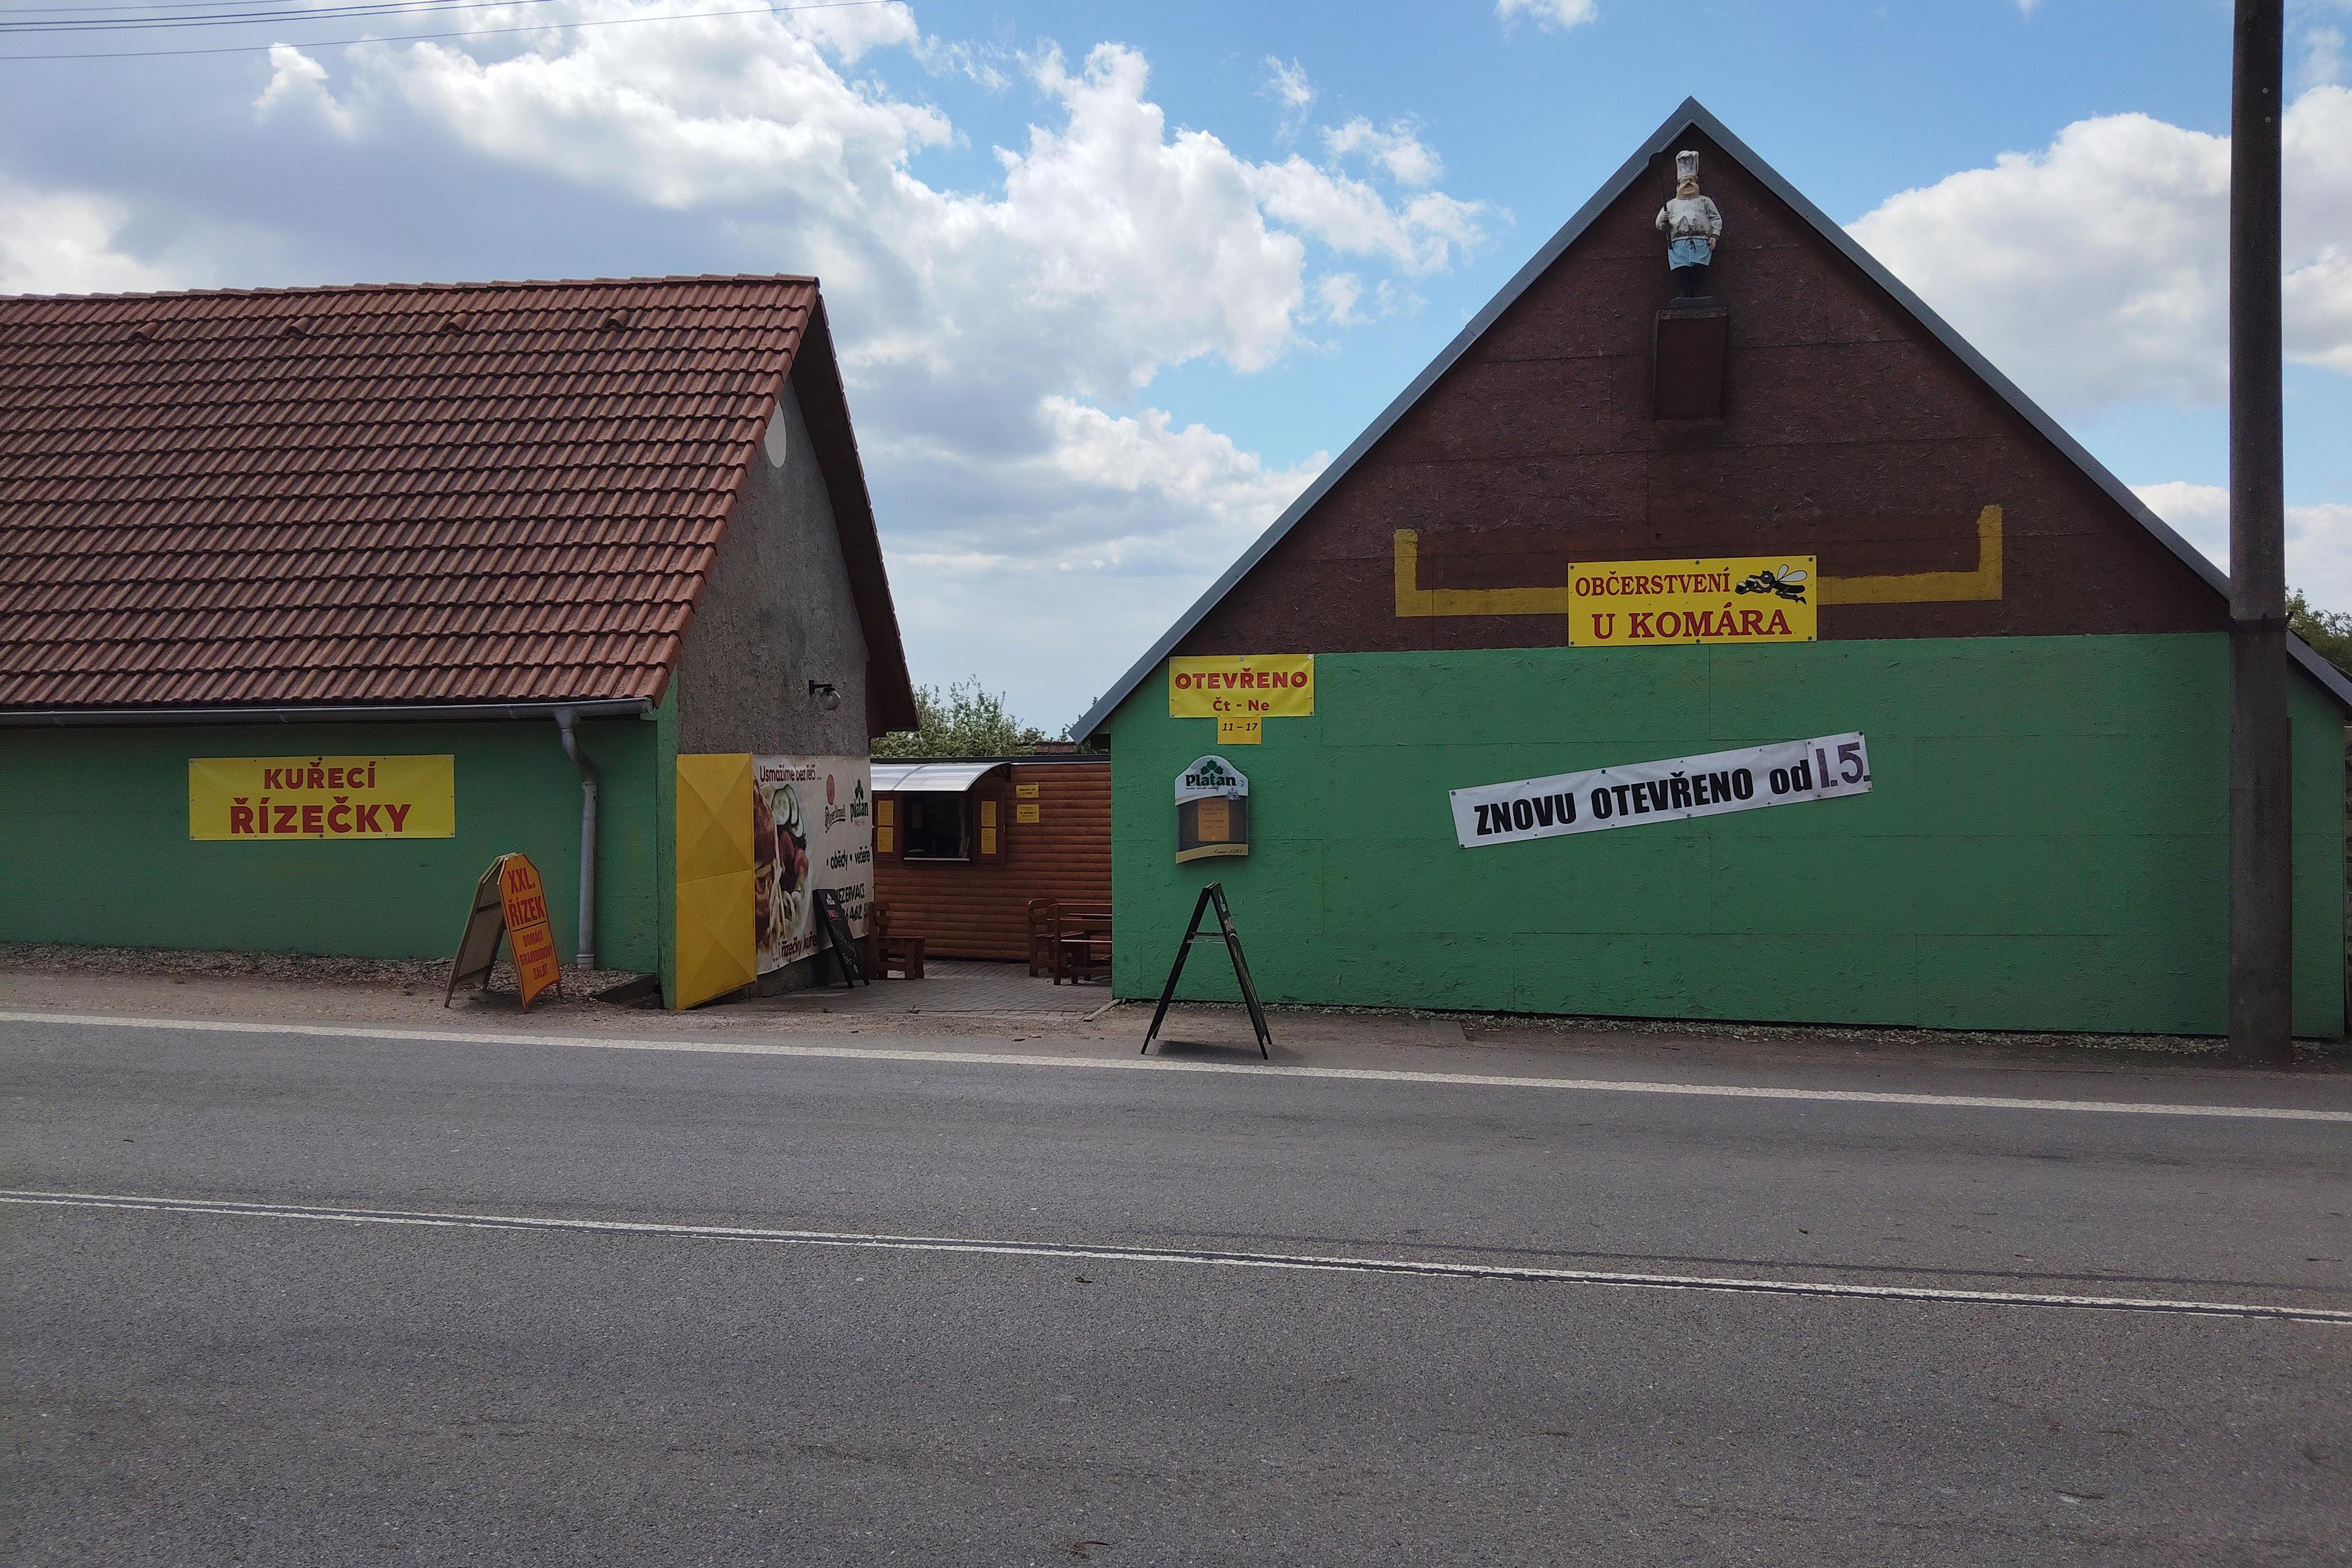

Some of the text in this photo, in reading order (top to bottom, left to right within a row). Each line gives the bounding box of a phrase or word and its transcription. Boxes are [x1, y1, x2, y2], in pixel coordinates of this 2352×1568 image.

[1575, 567, 1731, 597] OBČERSTVENÍ
[1591, 602, 1792, 639] U KOMÁRA
[1175, 667, 1308, 690] OTEVŘENO
[1212, 697, 1231, 711] Čt
[1248, 700, 1270, 711] Ne
[1222, 723, 1234, 731] 11
[1245, 723, 1258, 731] 17
[264, 761, 377, 789] KUŘECÍ
[760, 764, 794, 783] Usmažíme
[794, 765, 806, 781] bez
[1474, 792, 1576, 836] ZNOVU
[1591, 768, 1754, 820] OTEVŘENO
[1769, 759, 1812, 794] od
[230, 796, 412, 834] ŘÍZEČKY
[830, 846, 870, 871] obědy večeře
[508, 895, 545, 927] ŘÍZEK
[850, 904, 863, 921] 462
[781, 936, 803, 958] řízečky
[533, 962, 548, 980] SALÁT
